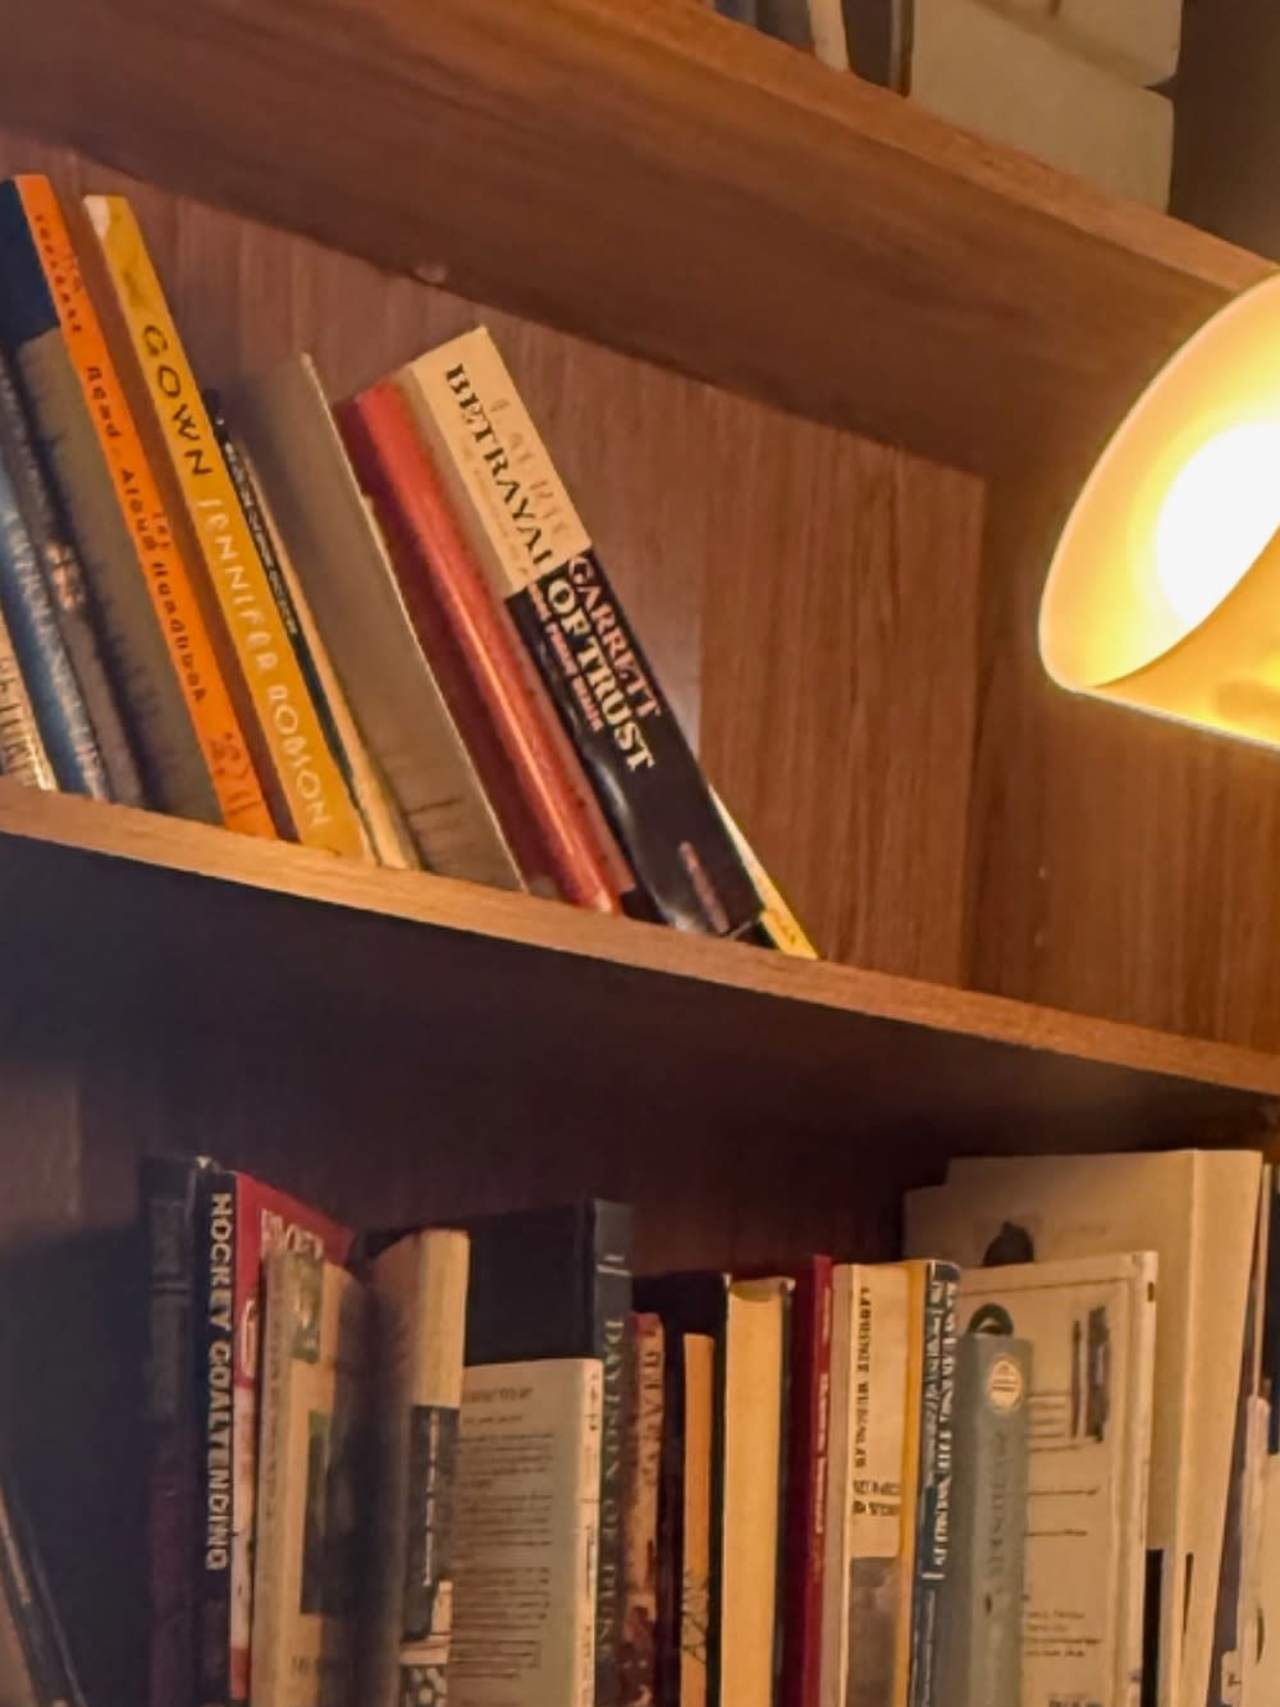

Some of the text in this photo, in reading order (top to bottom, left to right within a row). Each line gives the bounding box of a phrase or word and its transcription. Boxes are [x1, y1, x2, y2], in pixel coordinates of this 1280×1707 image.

[141, 324, 212, 479] GOWN
[445, 362, 554, 567] BETRAYAL
[543, 580, 589, 644] OF
[576, 641, 655, 771] TRUST
[196, 498, 279, 674] JENNIFER
[268, 684, 331, 828] ROBSON
[566, 554, 660, 720] GARRETT
[204, 1192, 235, 1571] HOCKEY GOALTENDING
